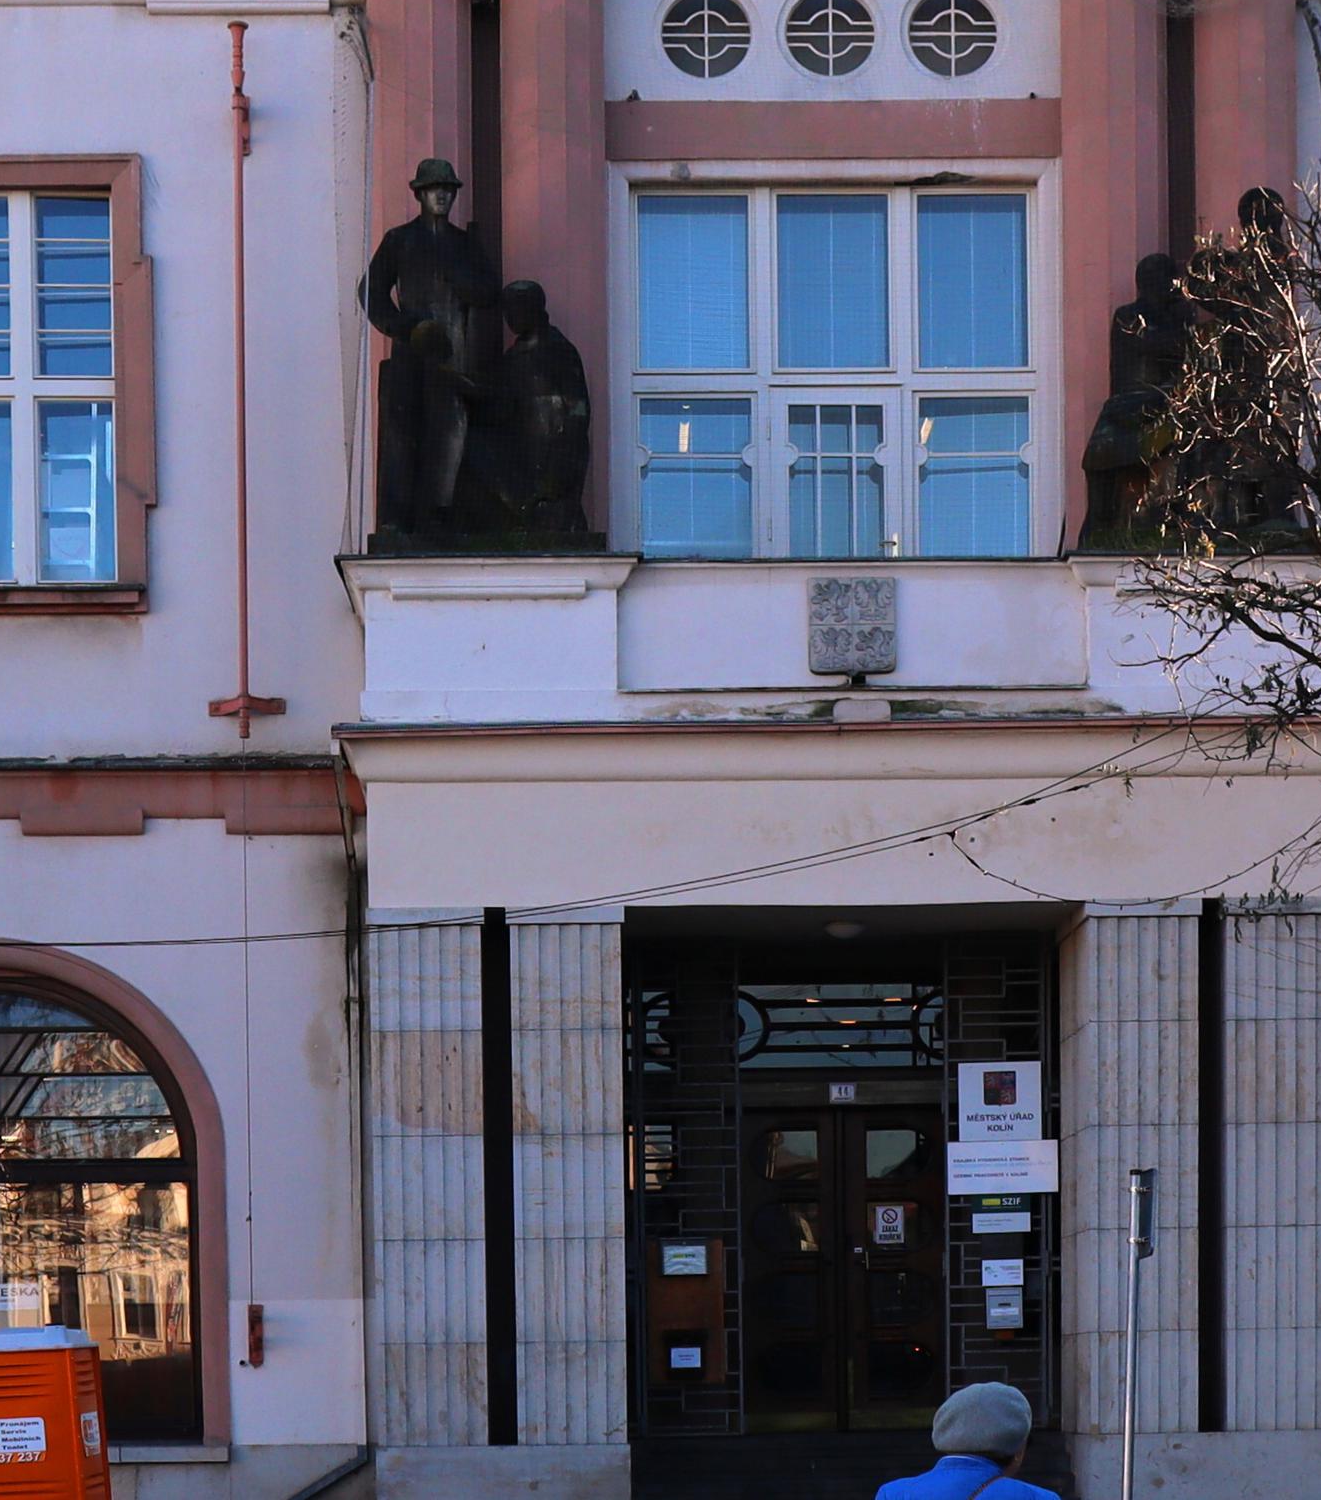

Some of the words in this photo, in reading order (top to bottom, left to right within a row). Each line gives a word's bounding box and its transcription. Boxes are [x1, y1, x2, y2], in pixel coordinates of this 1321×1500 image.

[966, 1113, 1007, 1122] MĚSTSKÝ
[1009, 1112, 1035, 1122] ÚŘAD
[986, 1123, 1014, 1132] KOLÍN
[1002, 1197, 1022, 1206] SZIF
[17, 1451, 41, 1462] 237
